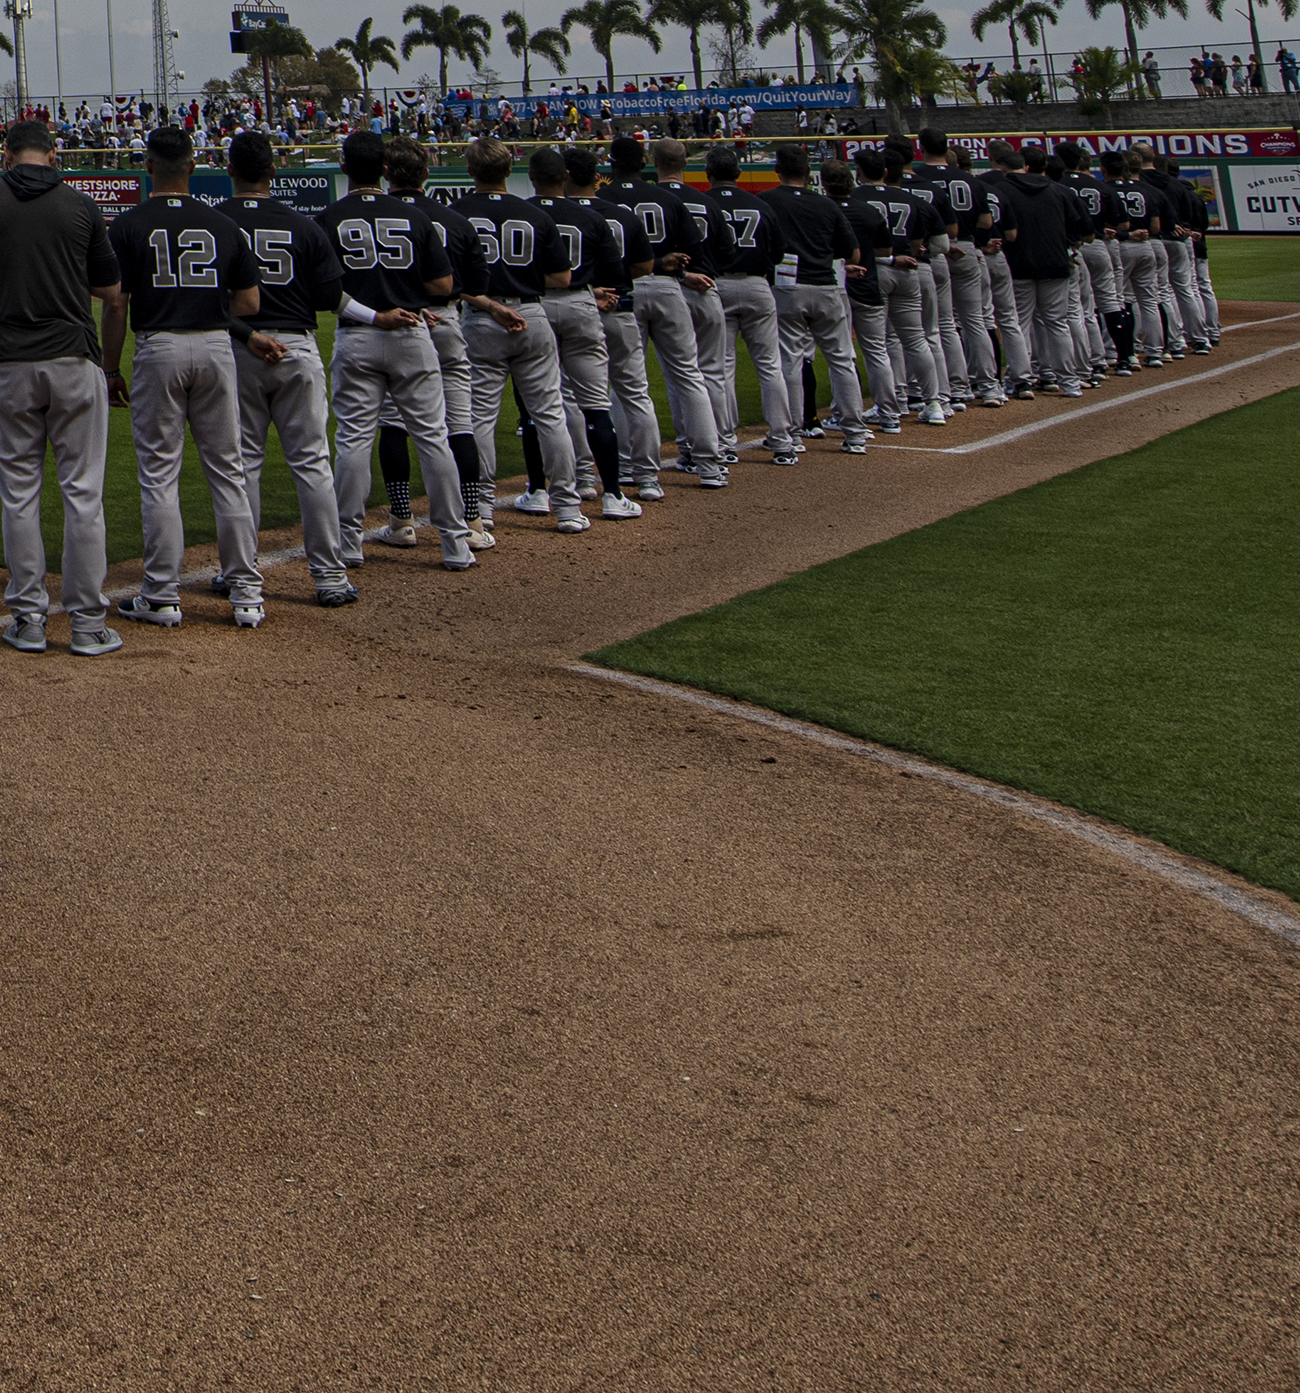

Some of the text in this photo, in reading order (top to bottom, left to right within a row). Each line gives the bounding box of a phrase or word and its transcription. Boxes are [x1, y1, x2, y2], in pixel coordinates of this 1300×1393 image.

[1247, 175, 1296, 189] SAN DIEGO
[149, 229, 218, 288] 12
[240, 228, 294, 285] 5
[337, 218, 414, 269] 95
[467, 217, 534, 266] 60
